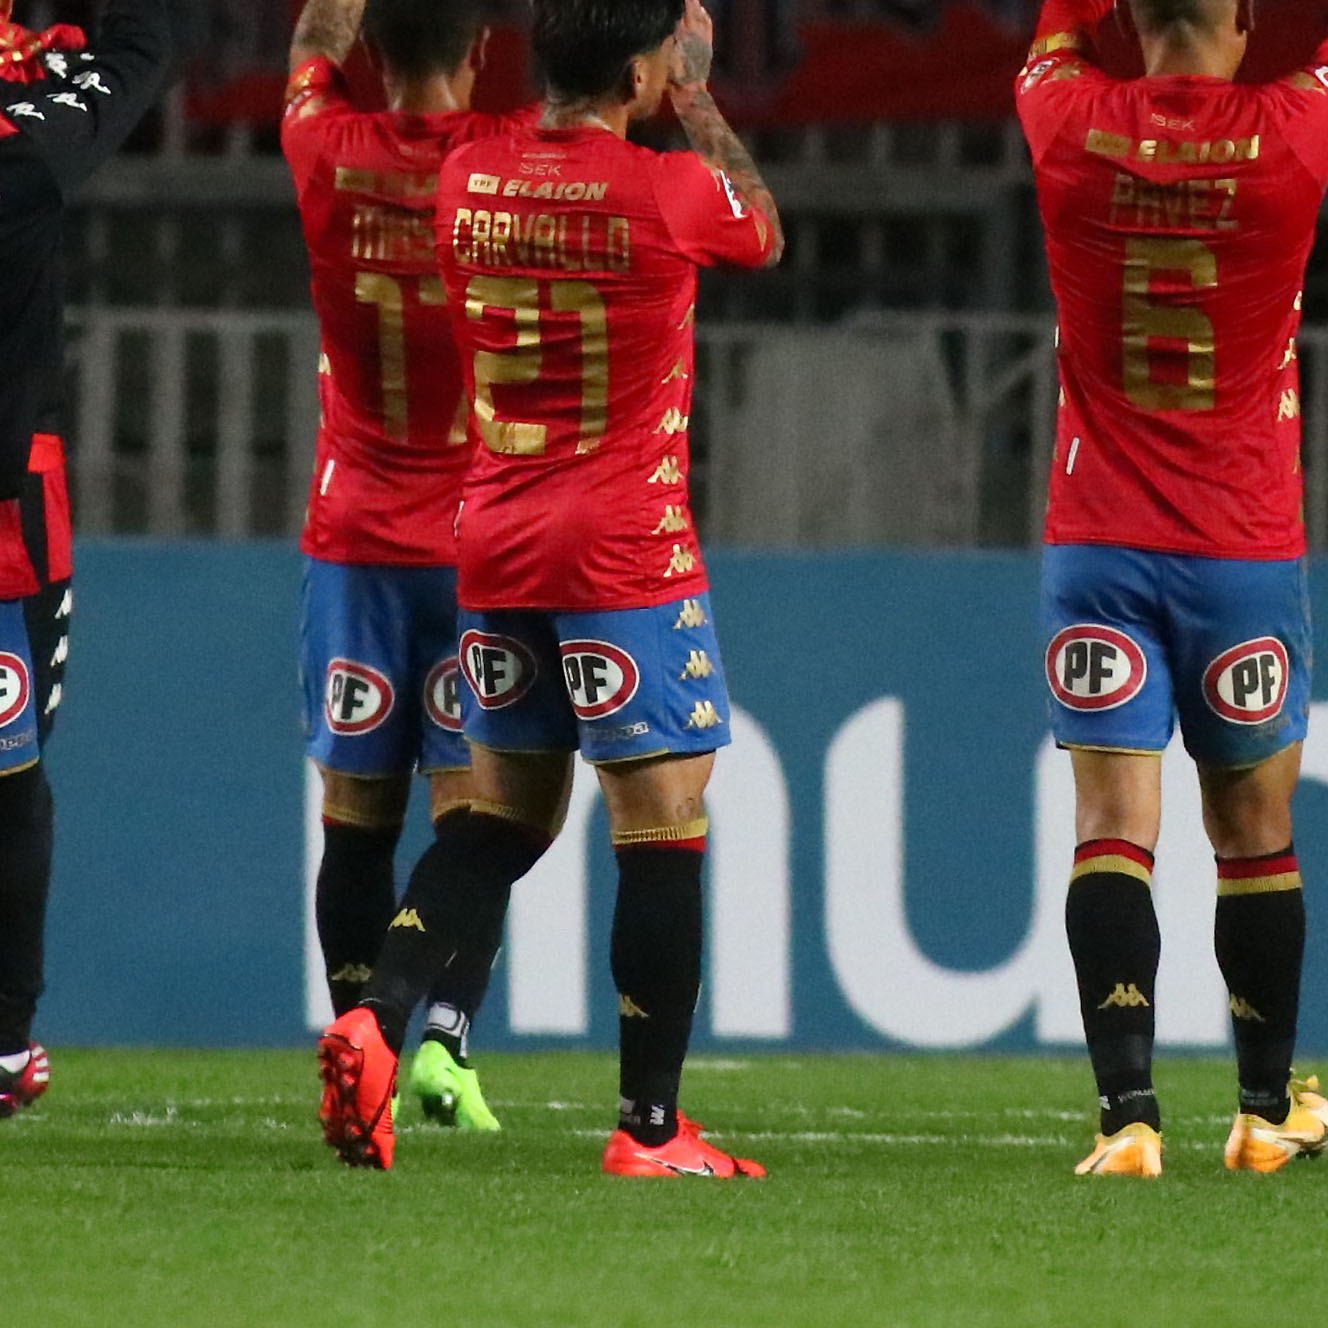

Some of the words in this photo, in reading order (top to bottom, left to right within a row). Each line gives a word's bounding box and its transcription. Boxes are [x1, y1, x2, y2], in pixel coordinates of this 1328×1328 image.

[1137, 134, 1260, 164] ELAION
[502, 178, 609, 202] ELAION
[452, 208, 631, 273] CARVALLO
[1121, 238, 1219, 410] 6
[464, 274, 610, 455] 21
[472, 645, 507, 695] PF
[562, 655, 608, 703] PF
[1064, 642, 1116, 693] PF
[1232, 655, 1276, 707] PF
[333, 674, 370, 720] PF
